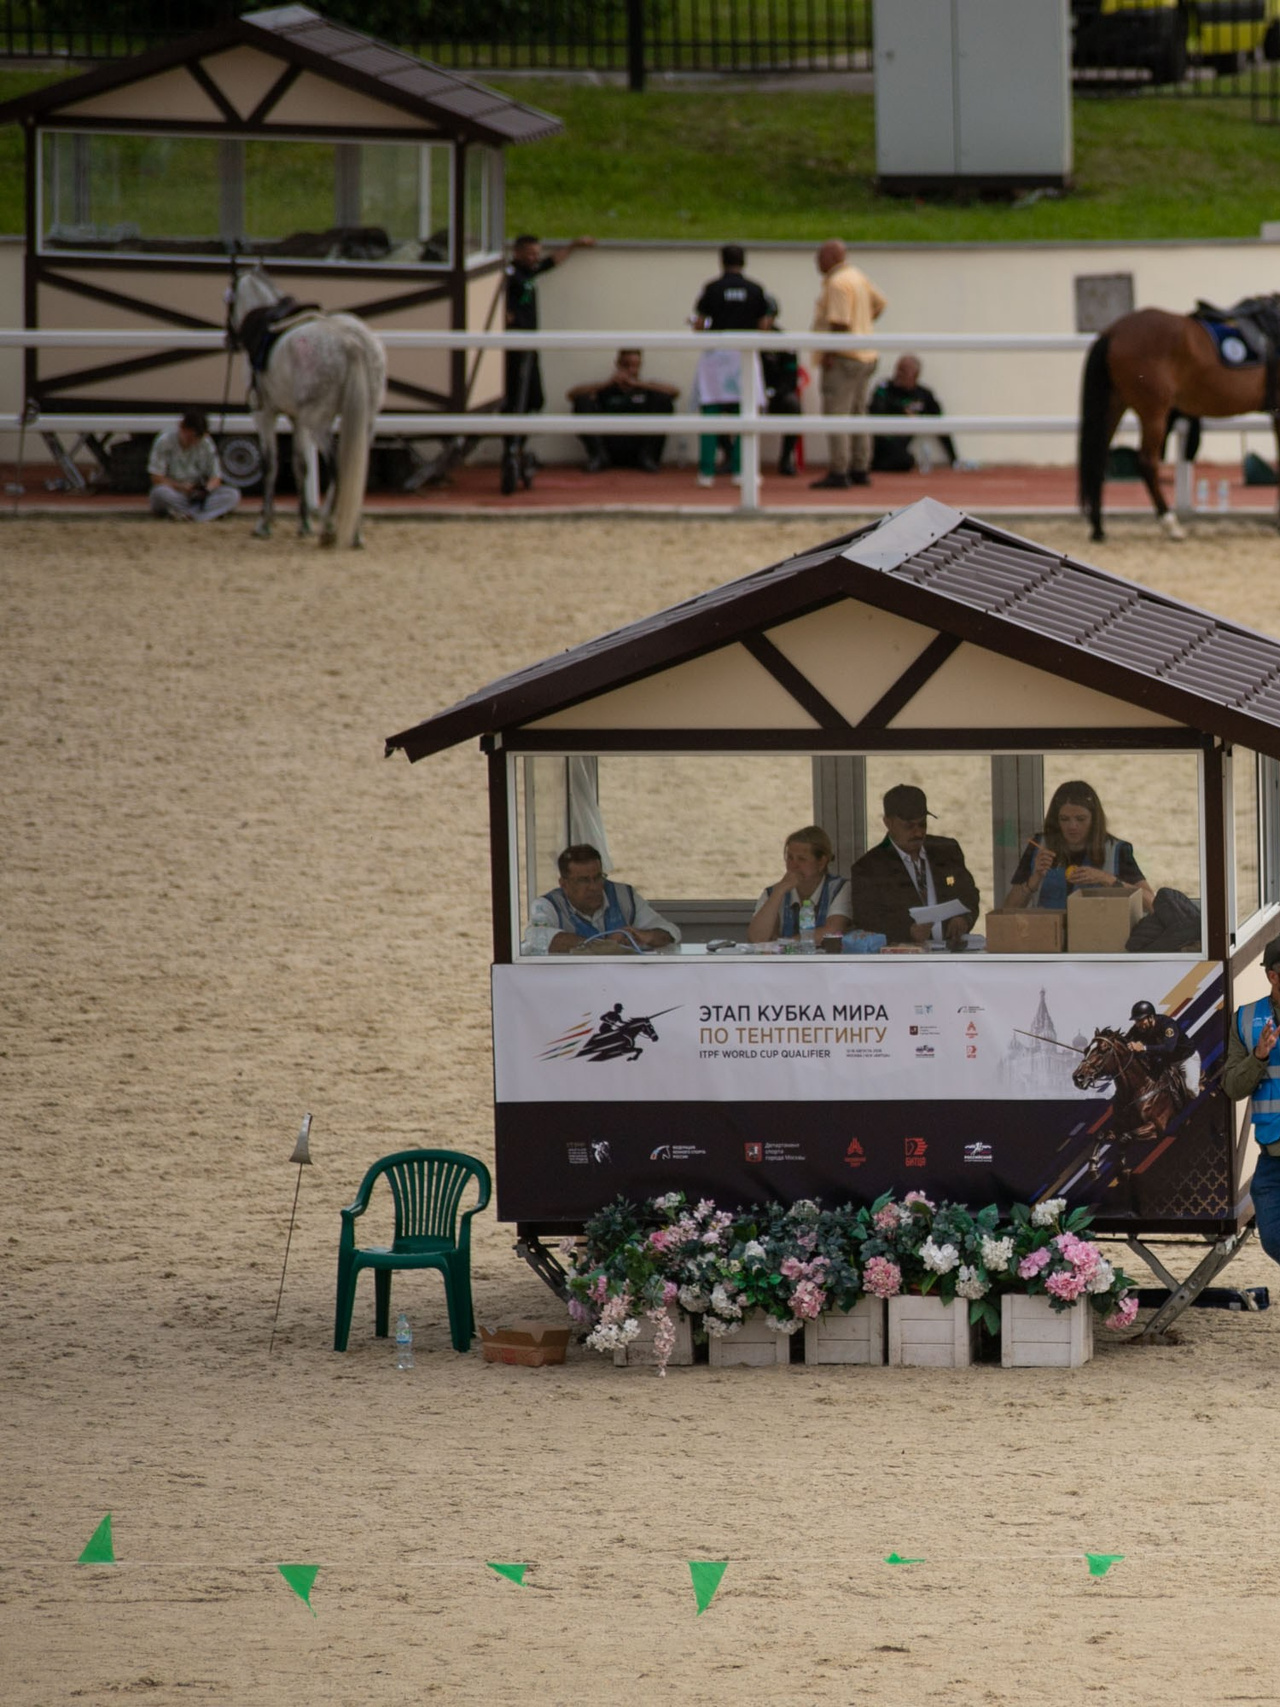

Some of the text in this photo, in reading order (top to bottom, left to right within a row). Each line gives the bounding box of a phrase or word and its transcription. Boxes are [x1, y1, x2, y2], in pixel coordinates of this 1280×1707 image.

[699, 1004, 889, 1022] ЭТАП КУБКА МИРА
[700, 1027, 887, 1044] ПО ТЕНТПЕГГИНГУ
[700, 1050, 831, 1059] ITPF WORLD CUP QUALIFIER
